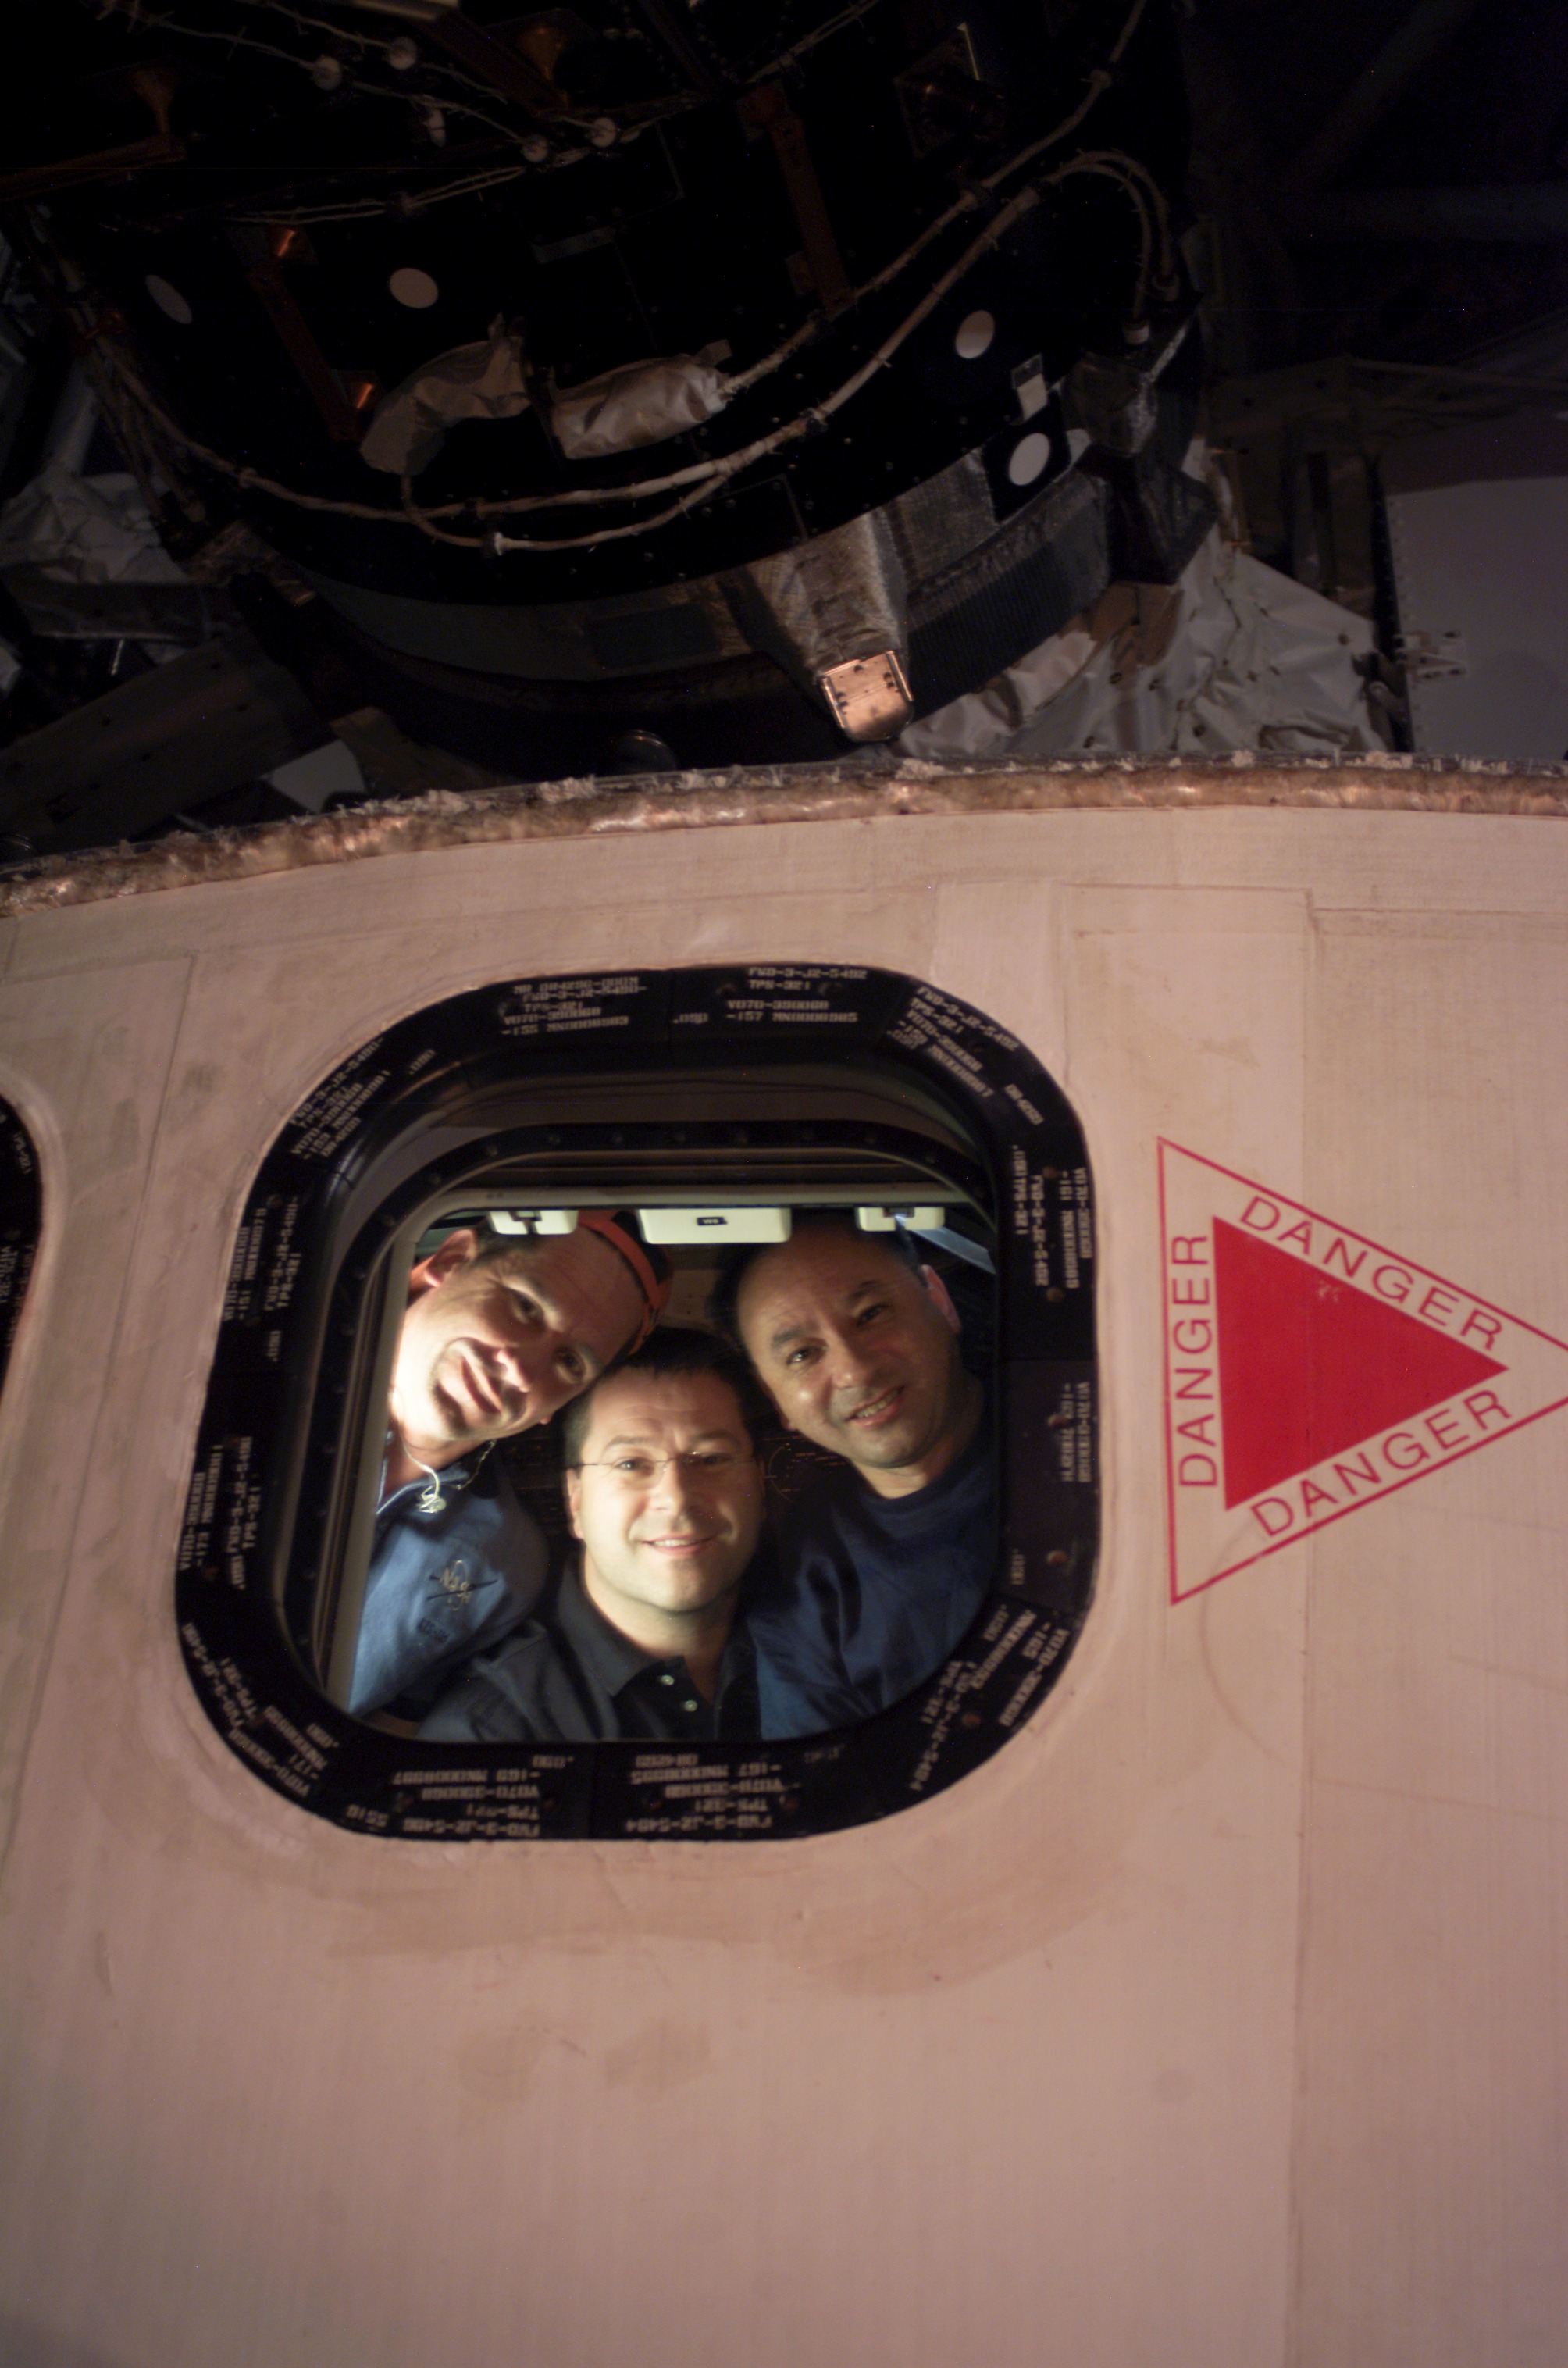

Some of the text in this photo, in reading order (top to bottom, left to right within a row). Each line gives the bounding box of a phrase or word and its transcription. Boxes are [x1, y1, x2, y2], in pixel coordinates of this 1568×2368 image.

[1239, 1195, 1504, 1351] DANGER
[1171, 1234, 1217, 1487] DANGER
[1250, 1389, 1512, 1537] DANGER
